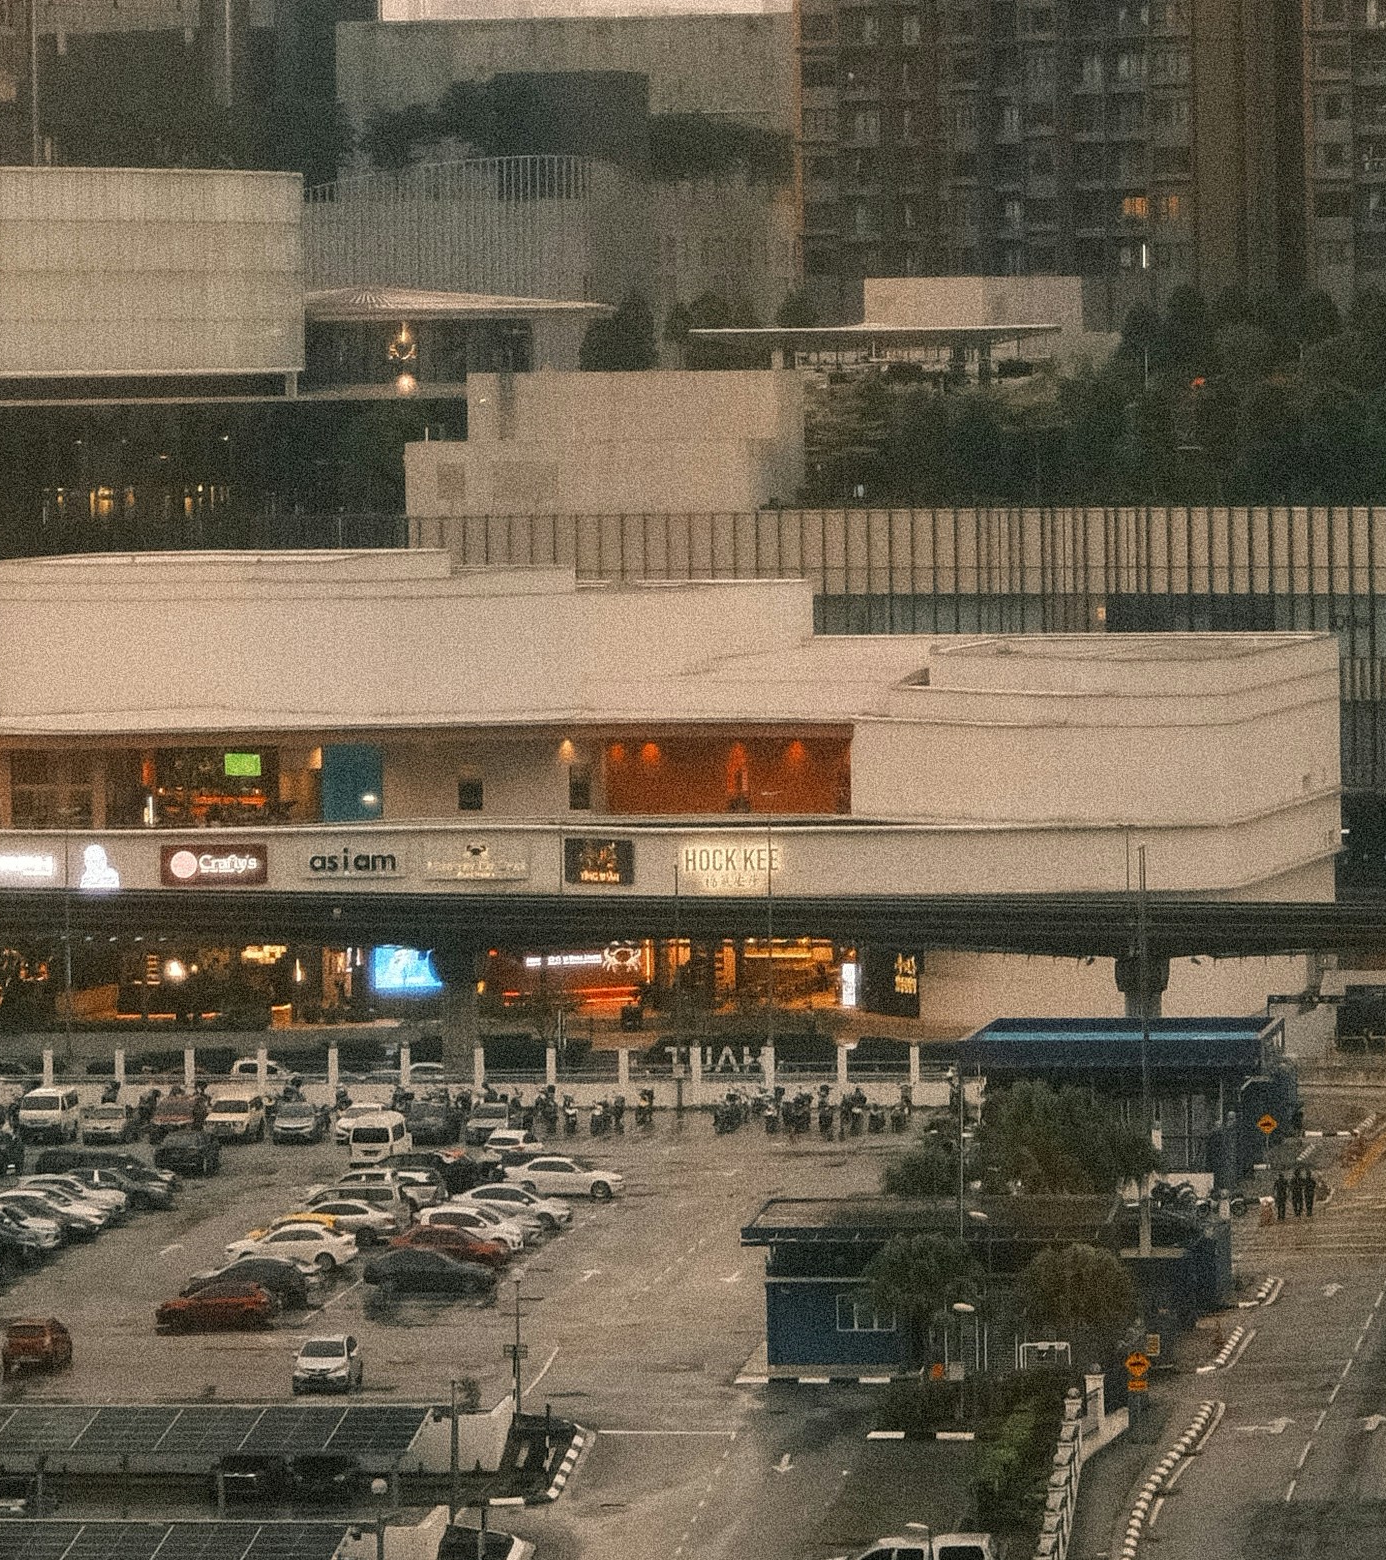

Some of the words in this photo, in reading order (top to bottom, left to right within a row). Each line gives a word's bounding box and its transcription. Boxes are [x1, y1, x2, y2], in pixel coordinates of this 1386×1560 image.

[309, 855, 339, 872] as
[353, 853, 397, 872] am
[685, 848, 737, 872] HOCK
[743, 847, 779, 872] KEE
